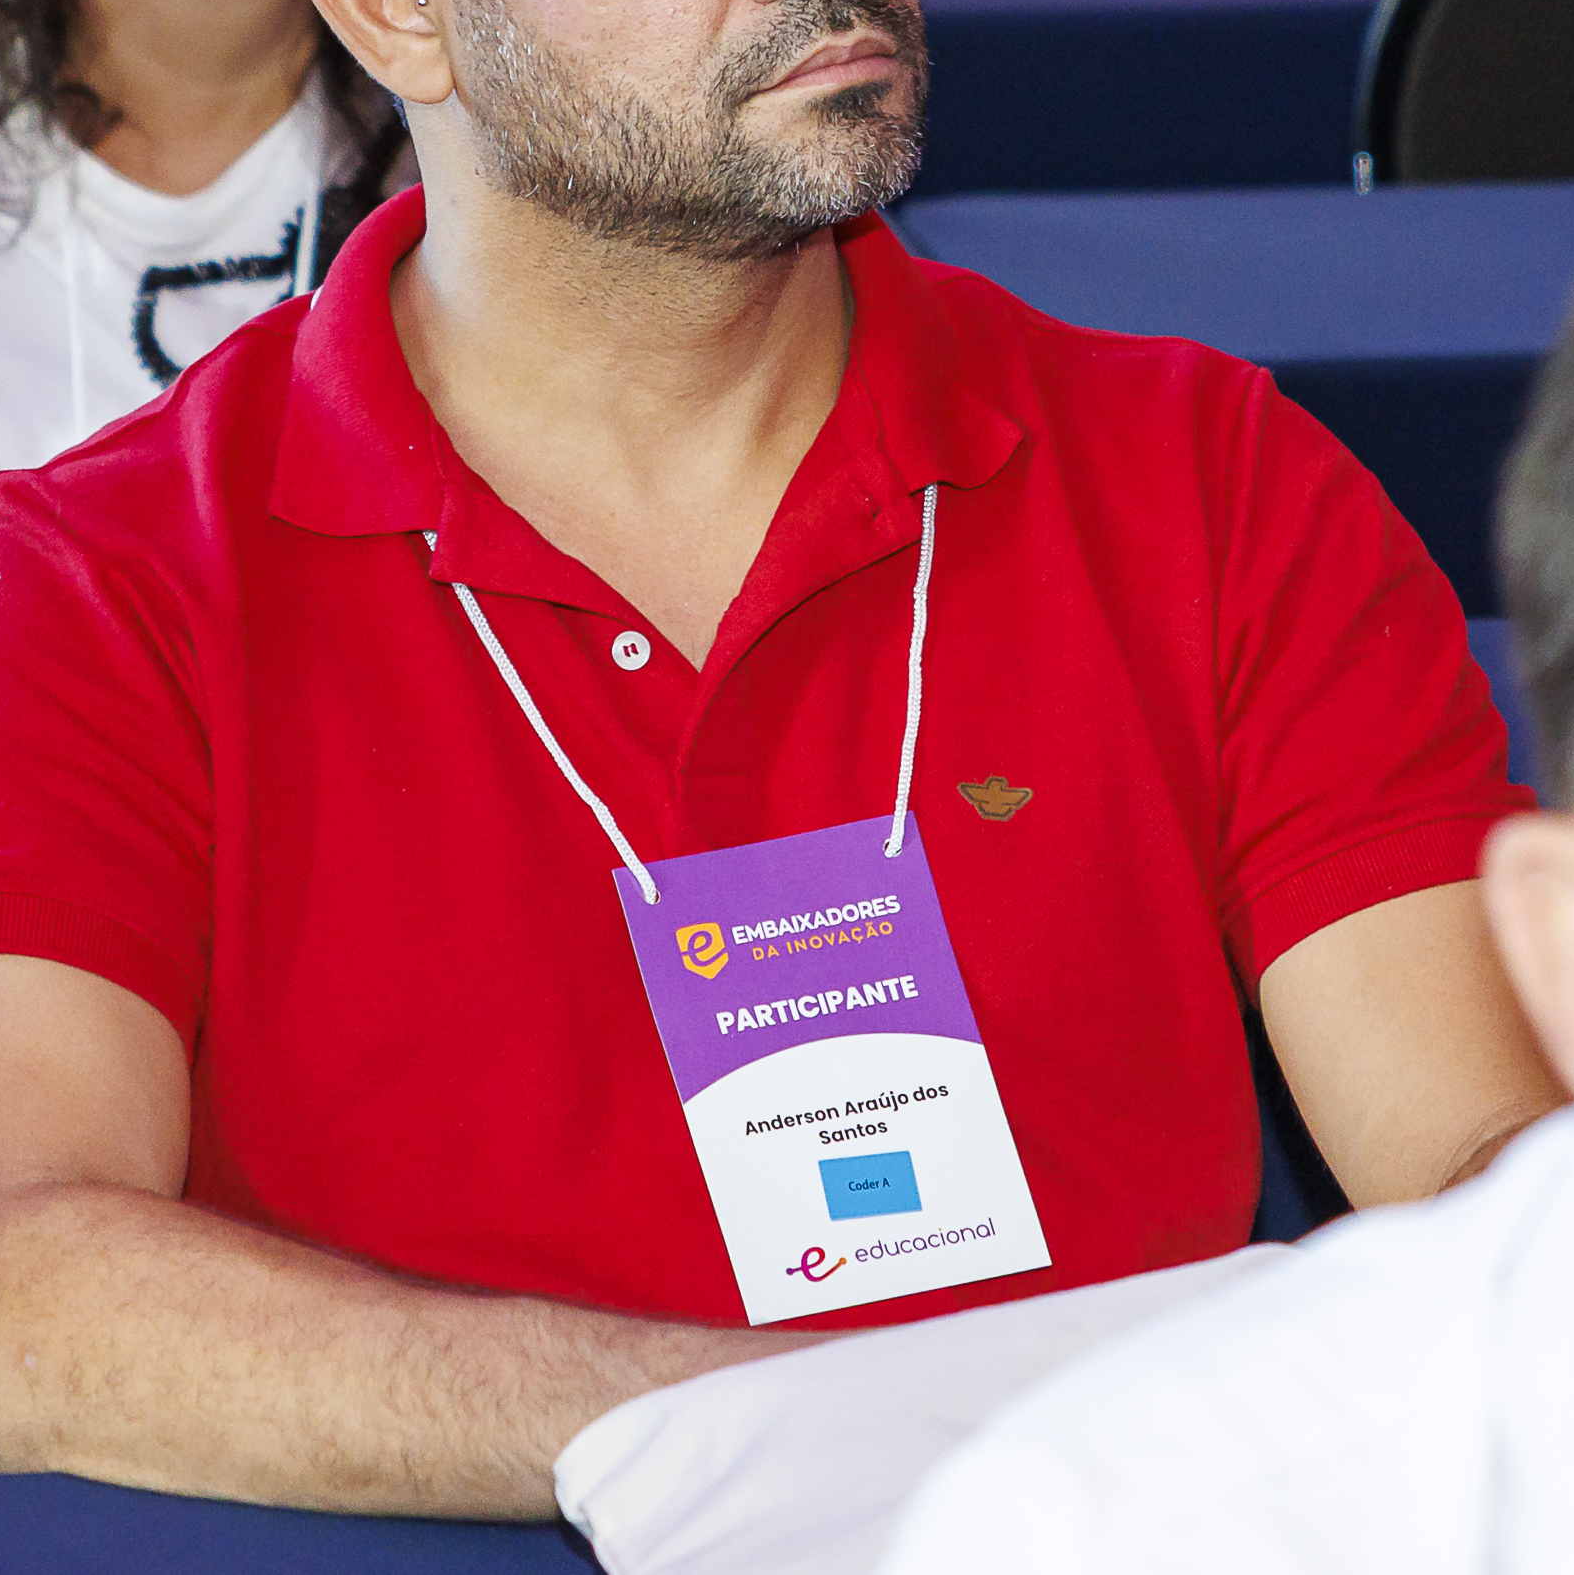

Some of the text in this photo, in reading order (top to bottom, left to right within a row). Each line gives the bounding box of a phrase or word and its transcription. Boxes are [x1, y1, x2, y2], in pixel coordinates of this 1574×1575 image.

[731, 894, 901, 945] EMBAIXADORES
[752, 920, 893, 961] DA INOVAÇÃO
[715, 974, 919, 1035] PARTICIPANTE
[744, 1085, 949, 1137] Anderson Araújo dos
[818, 1119, 888, 1145] Santos
[847, 1177, 891, 1192] Coder A
[854, 1216, 997, 1264] educacional
